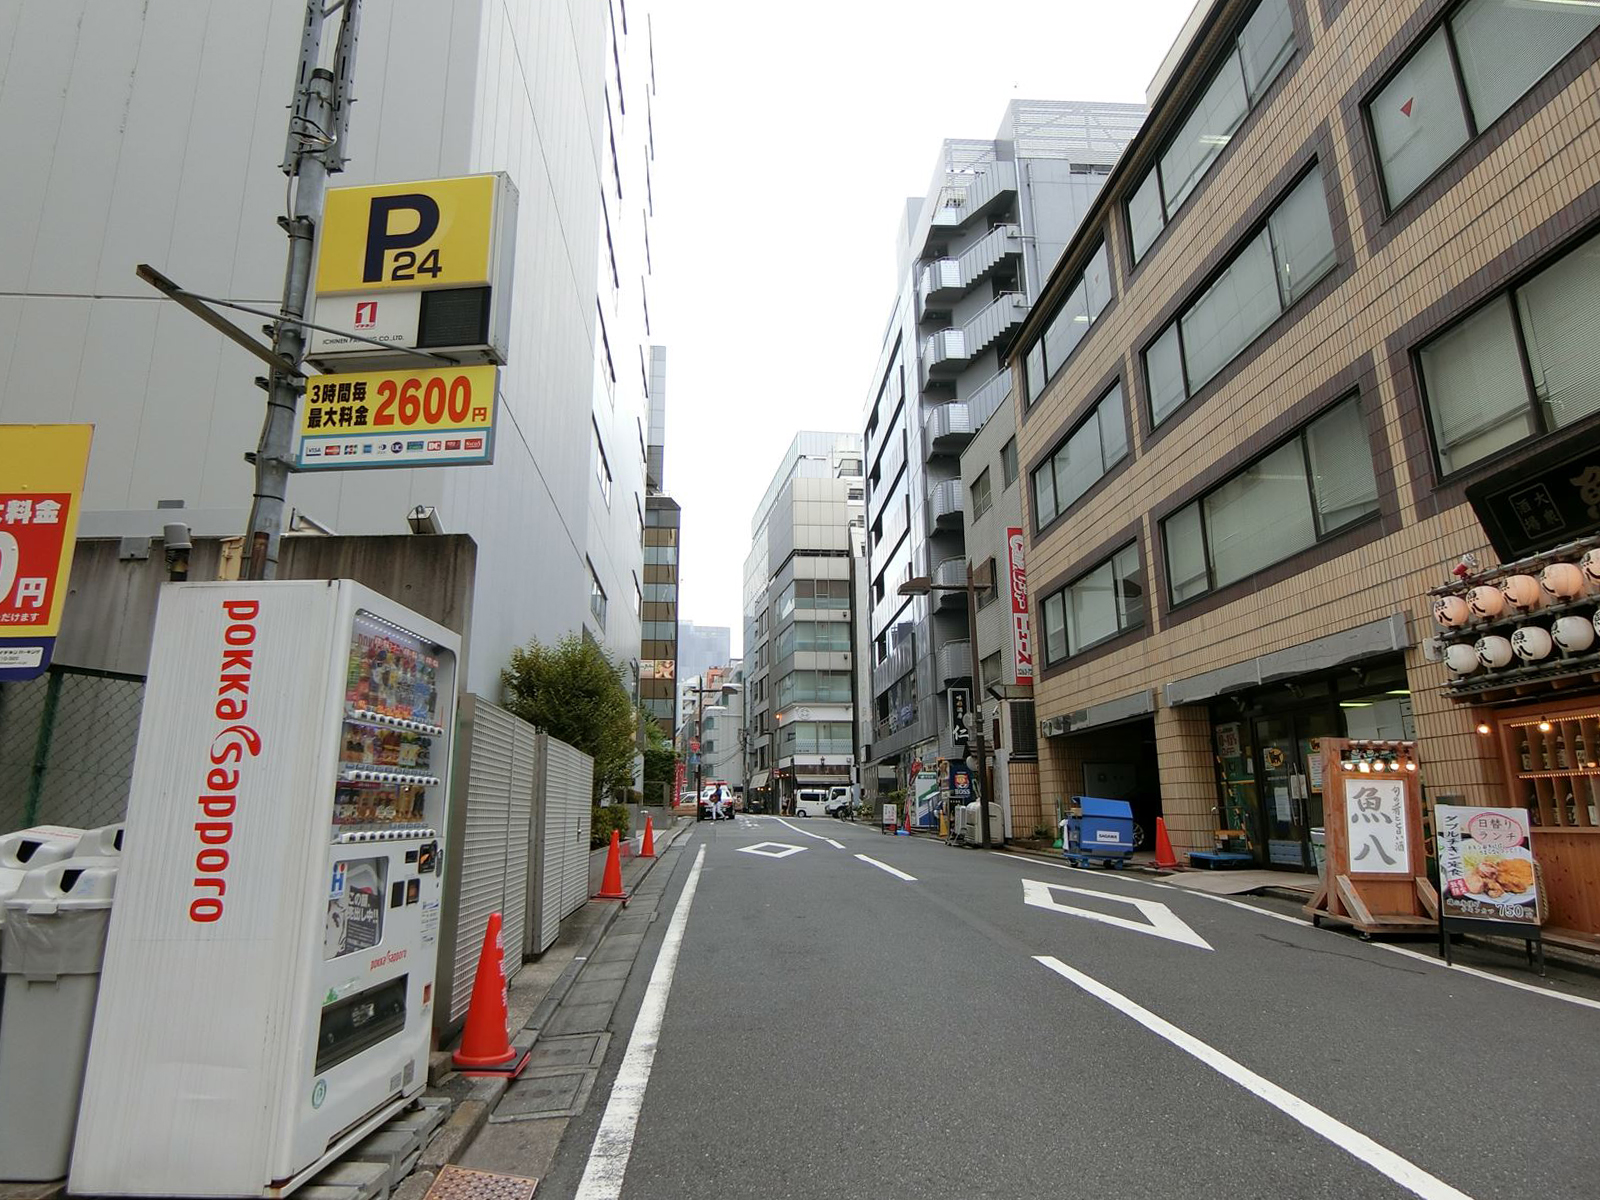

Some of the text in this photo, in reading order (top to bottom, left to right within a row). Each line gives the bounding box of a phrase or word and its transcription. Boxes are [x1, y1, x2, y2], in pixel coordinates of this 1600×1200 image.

[363, 194, 442, 282] P 24
[322, 337, 349, 345] ICHINEN
[310, 381, 367, 404] 3時間毎
[307, 406, 369, 428] 最大料金
[0, 499, 62, 525] 料金
[1351, 786, 1397, 865] 魚八
[1478, 818, 1512, 829] 日替り
[1444, 815, 1464, 876] ダブルチキン定食
[1479, 830, 1515, 841] ランチ
